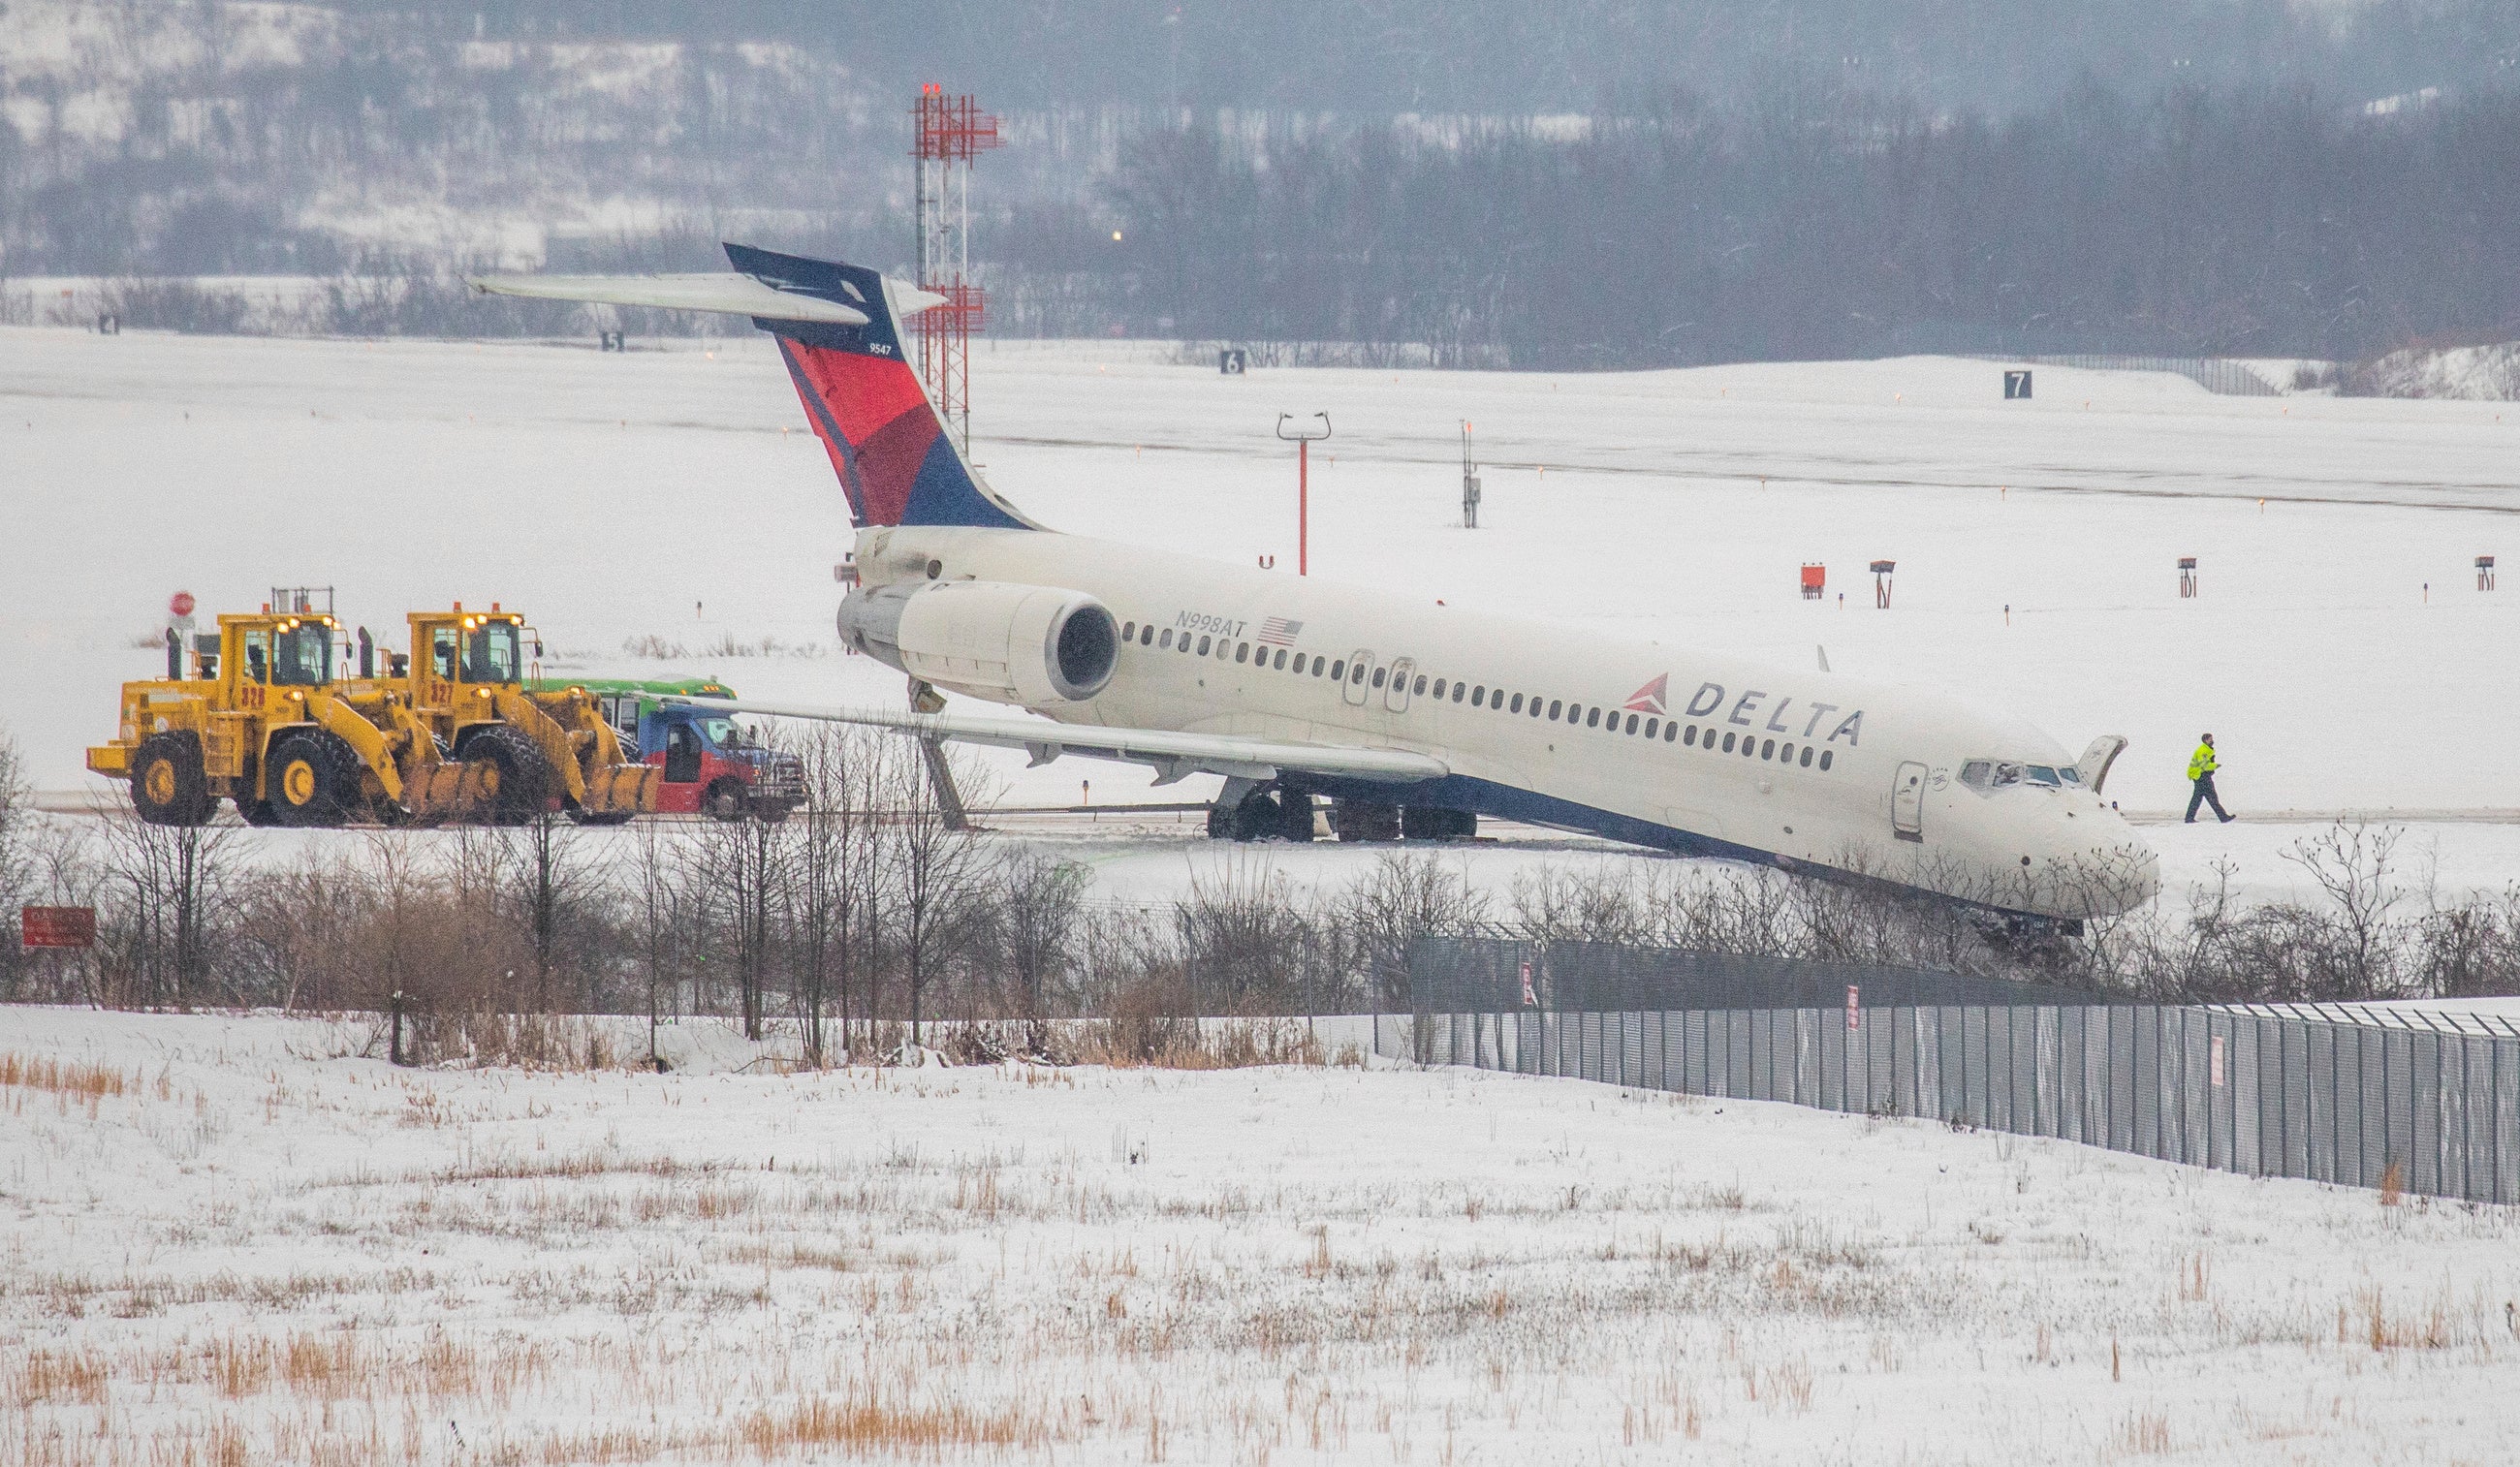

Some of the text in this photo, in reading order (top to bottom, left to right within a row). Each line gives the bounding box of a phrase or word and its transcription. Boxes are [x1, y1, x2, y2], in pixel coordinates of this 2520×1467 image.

[869, 343, 892, 356] 9547
[1226, 352, 1240, 373] 6
[2011, 372, 2026, 397] 7
[1176, 609, 1247, 638] N998AT
[1685, 681, 1865, 747] DELTA
